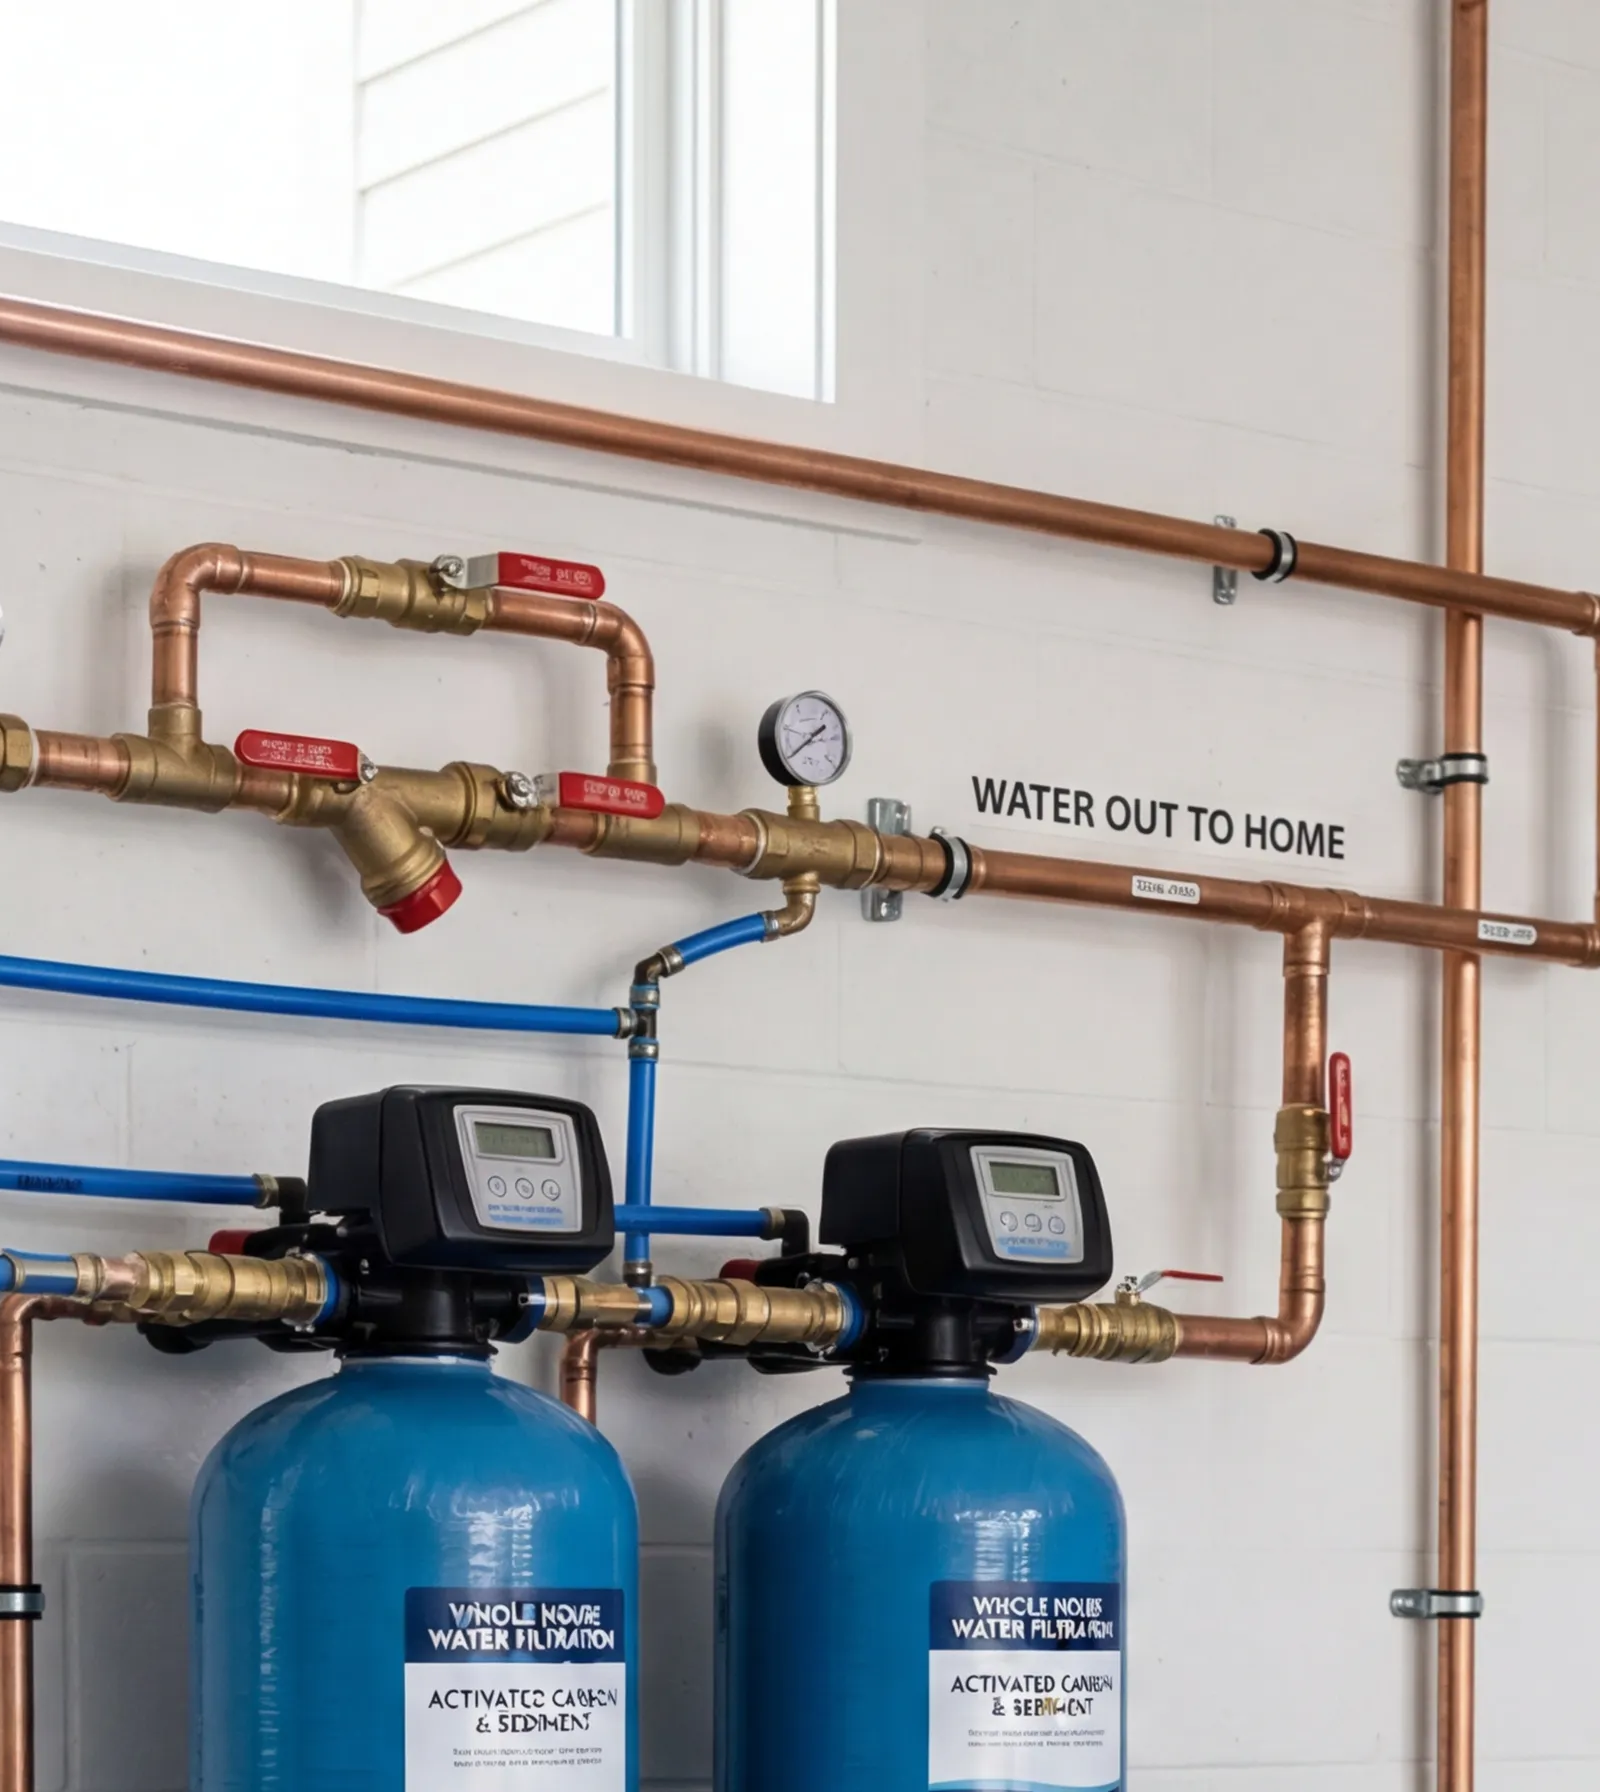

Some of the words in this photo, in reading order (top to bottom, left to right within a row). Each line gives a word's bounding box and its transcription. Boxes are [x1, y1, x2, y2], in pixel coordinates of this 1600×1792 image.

[971, 775, 1095, 828] WATER
[1105, 794, 1179, 839] OUT
[1187, 805, 1234, 845] TO
[1244, 813, 1345, 860] HOME
[427, 1627, 510, 1651] WATER
[951, 1618, 1025, 1640] WATER
[950, 1674, 1056, 1693] ACTIVATED
